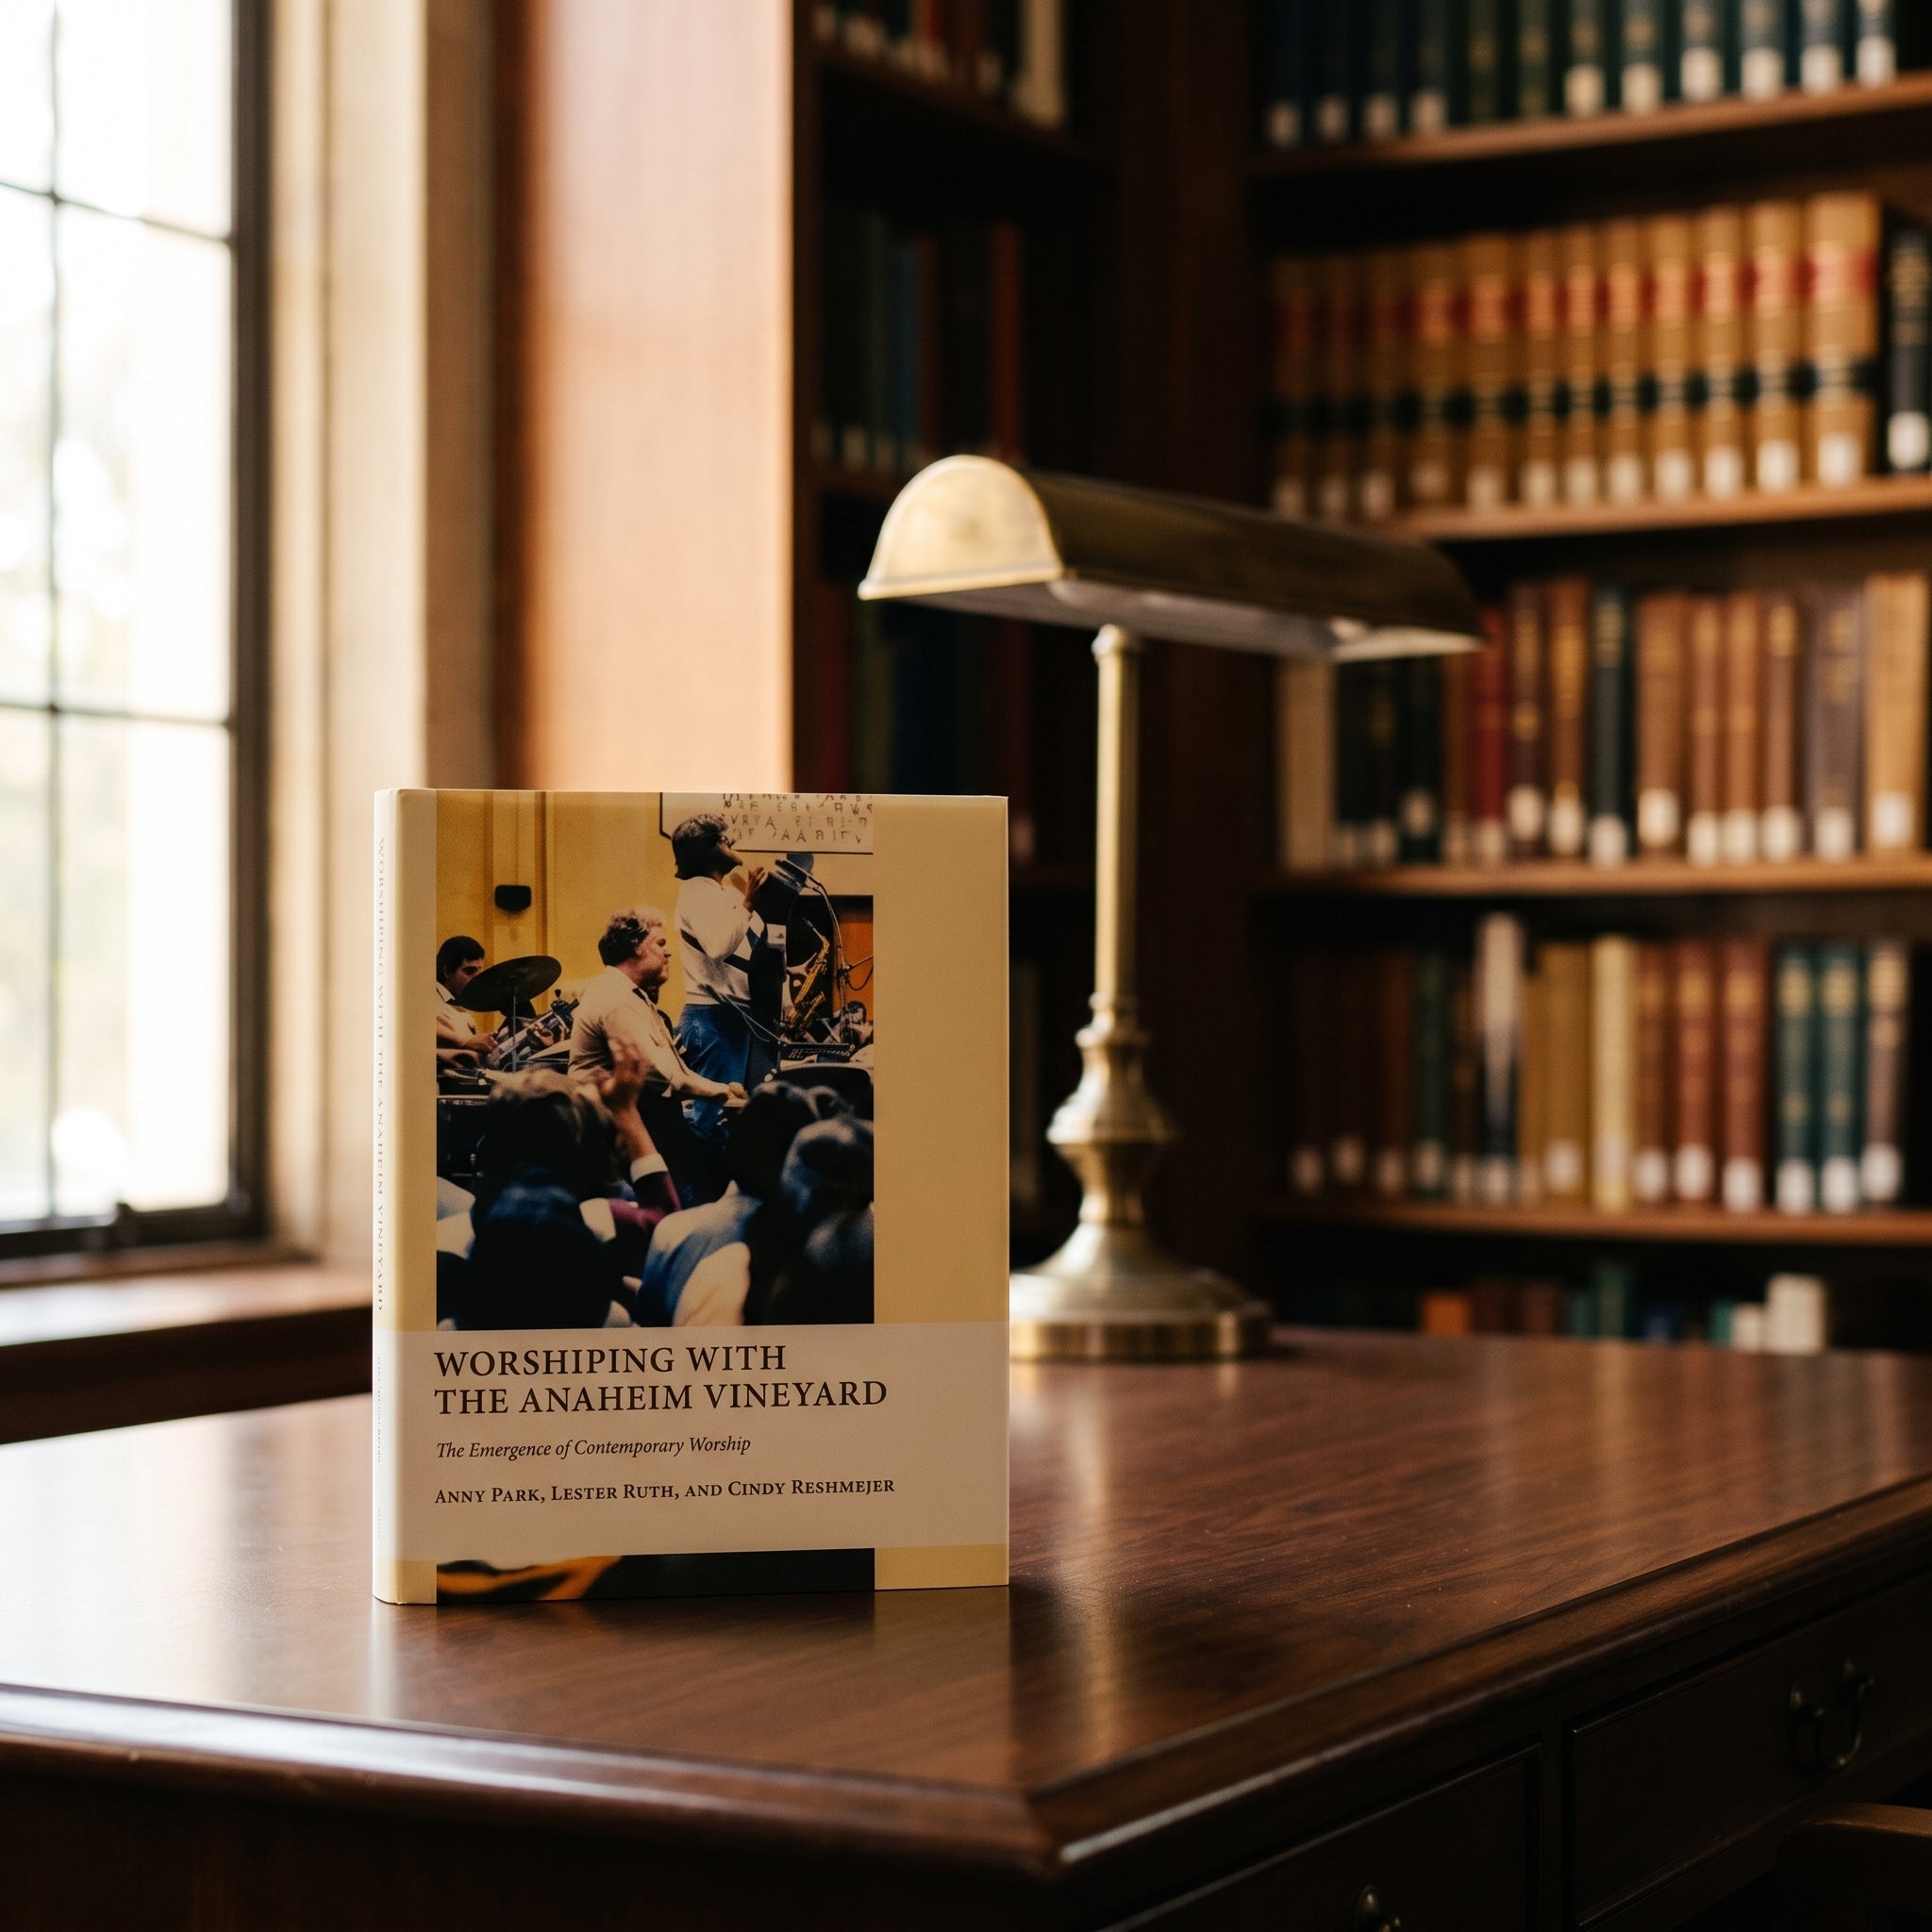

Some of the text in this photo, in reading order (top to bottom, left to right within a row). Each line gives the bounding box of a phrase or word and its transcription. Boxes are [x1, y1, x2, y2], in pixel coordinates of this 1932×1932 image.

[434, 1344, 787, 1377] WORSHIPING WITH
[434, 1380, 888, 1415] THE ANAHEIM VINEYARD
[437, 1435, 751, 1461] The Emergence of Contemporary Worship
[434, 1489, 487, 1504] ANNY
[491, 1487, 545, 1504] PARK,
[551, 1485, 618, 1501] LESTER
[624, 1483, 680, 1501] RUTH,
[685, 1484, 723, 1498] AND
[728, 1480, 787, 1496] CINDY
